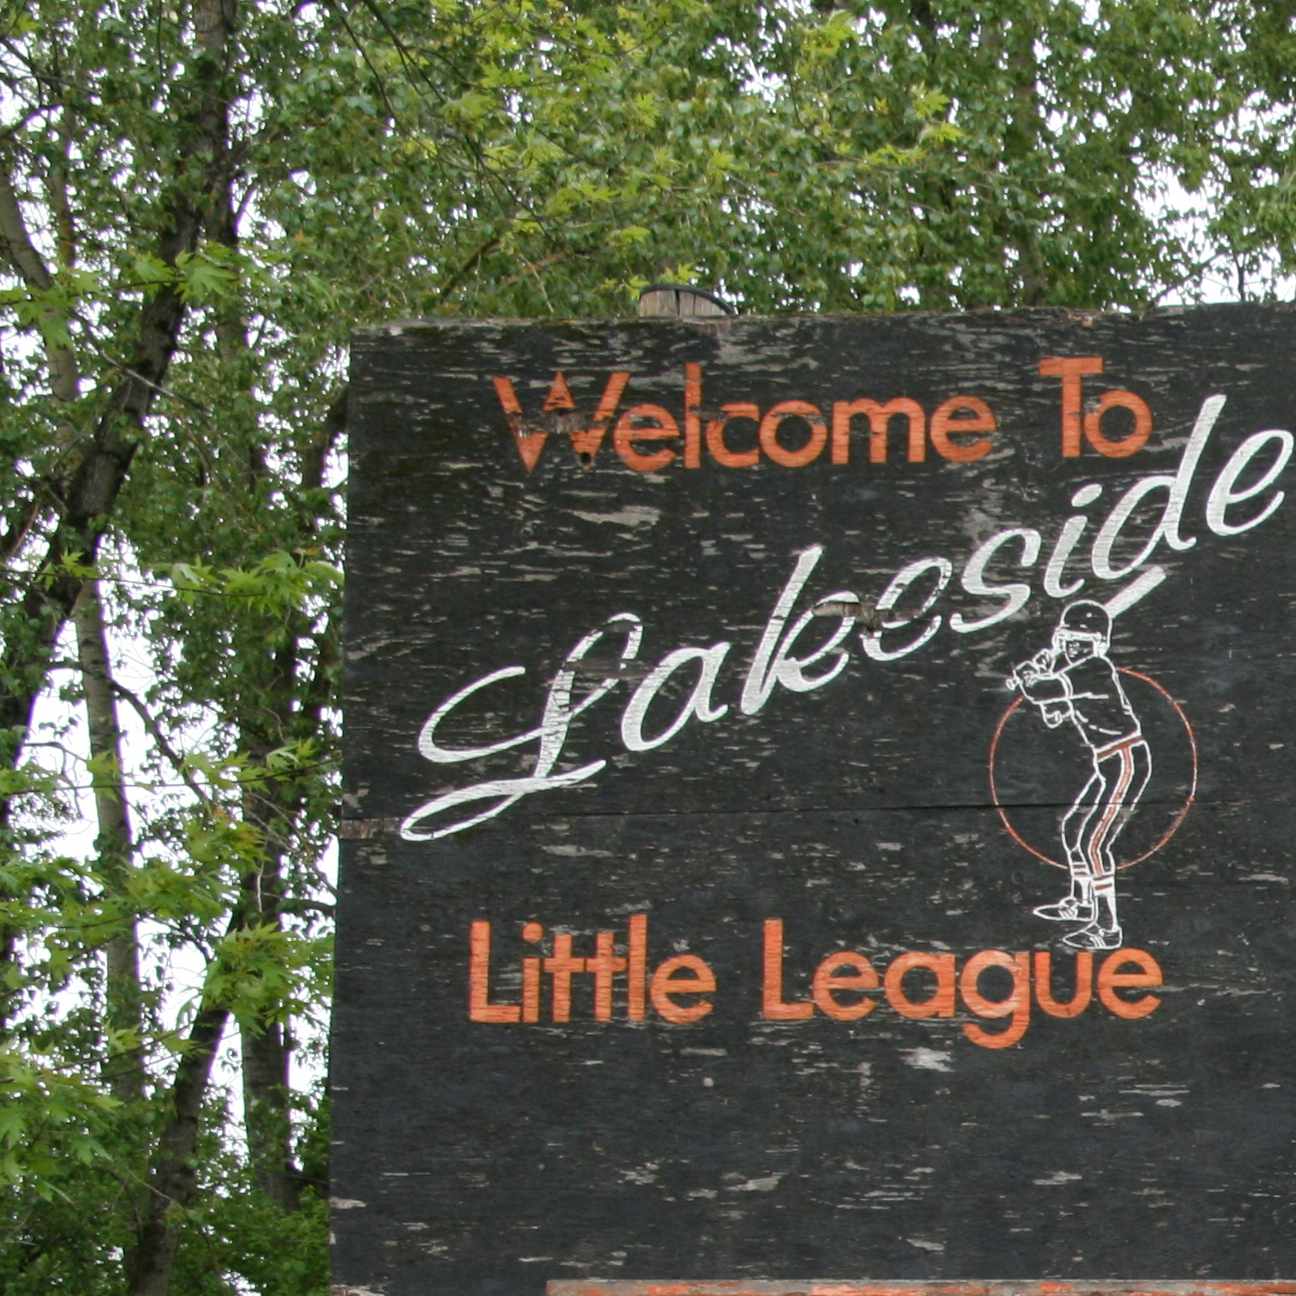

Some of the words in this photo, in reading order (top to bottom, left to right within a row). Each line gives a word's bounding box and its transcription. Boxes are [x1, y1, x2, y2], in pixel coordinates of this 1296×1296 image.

[493, 361, 997, 474] Welcome
[1039, 357, 1152, 459] To
[401, 394, 1295, 841] Lakeside
[469, 915, 717, 1024] Little
[763, 918, 1162, 1049] League
